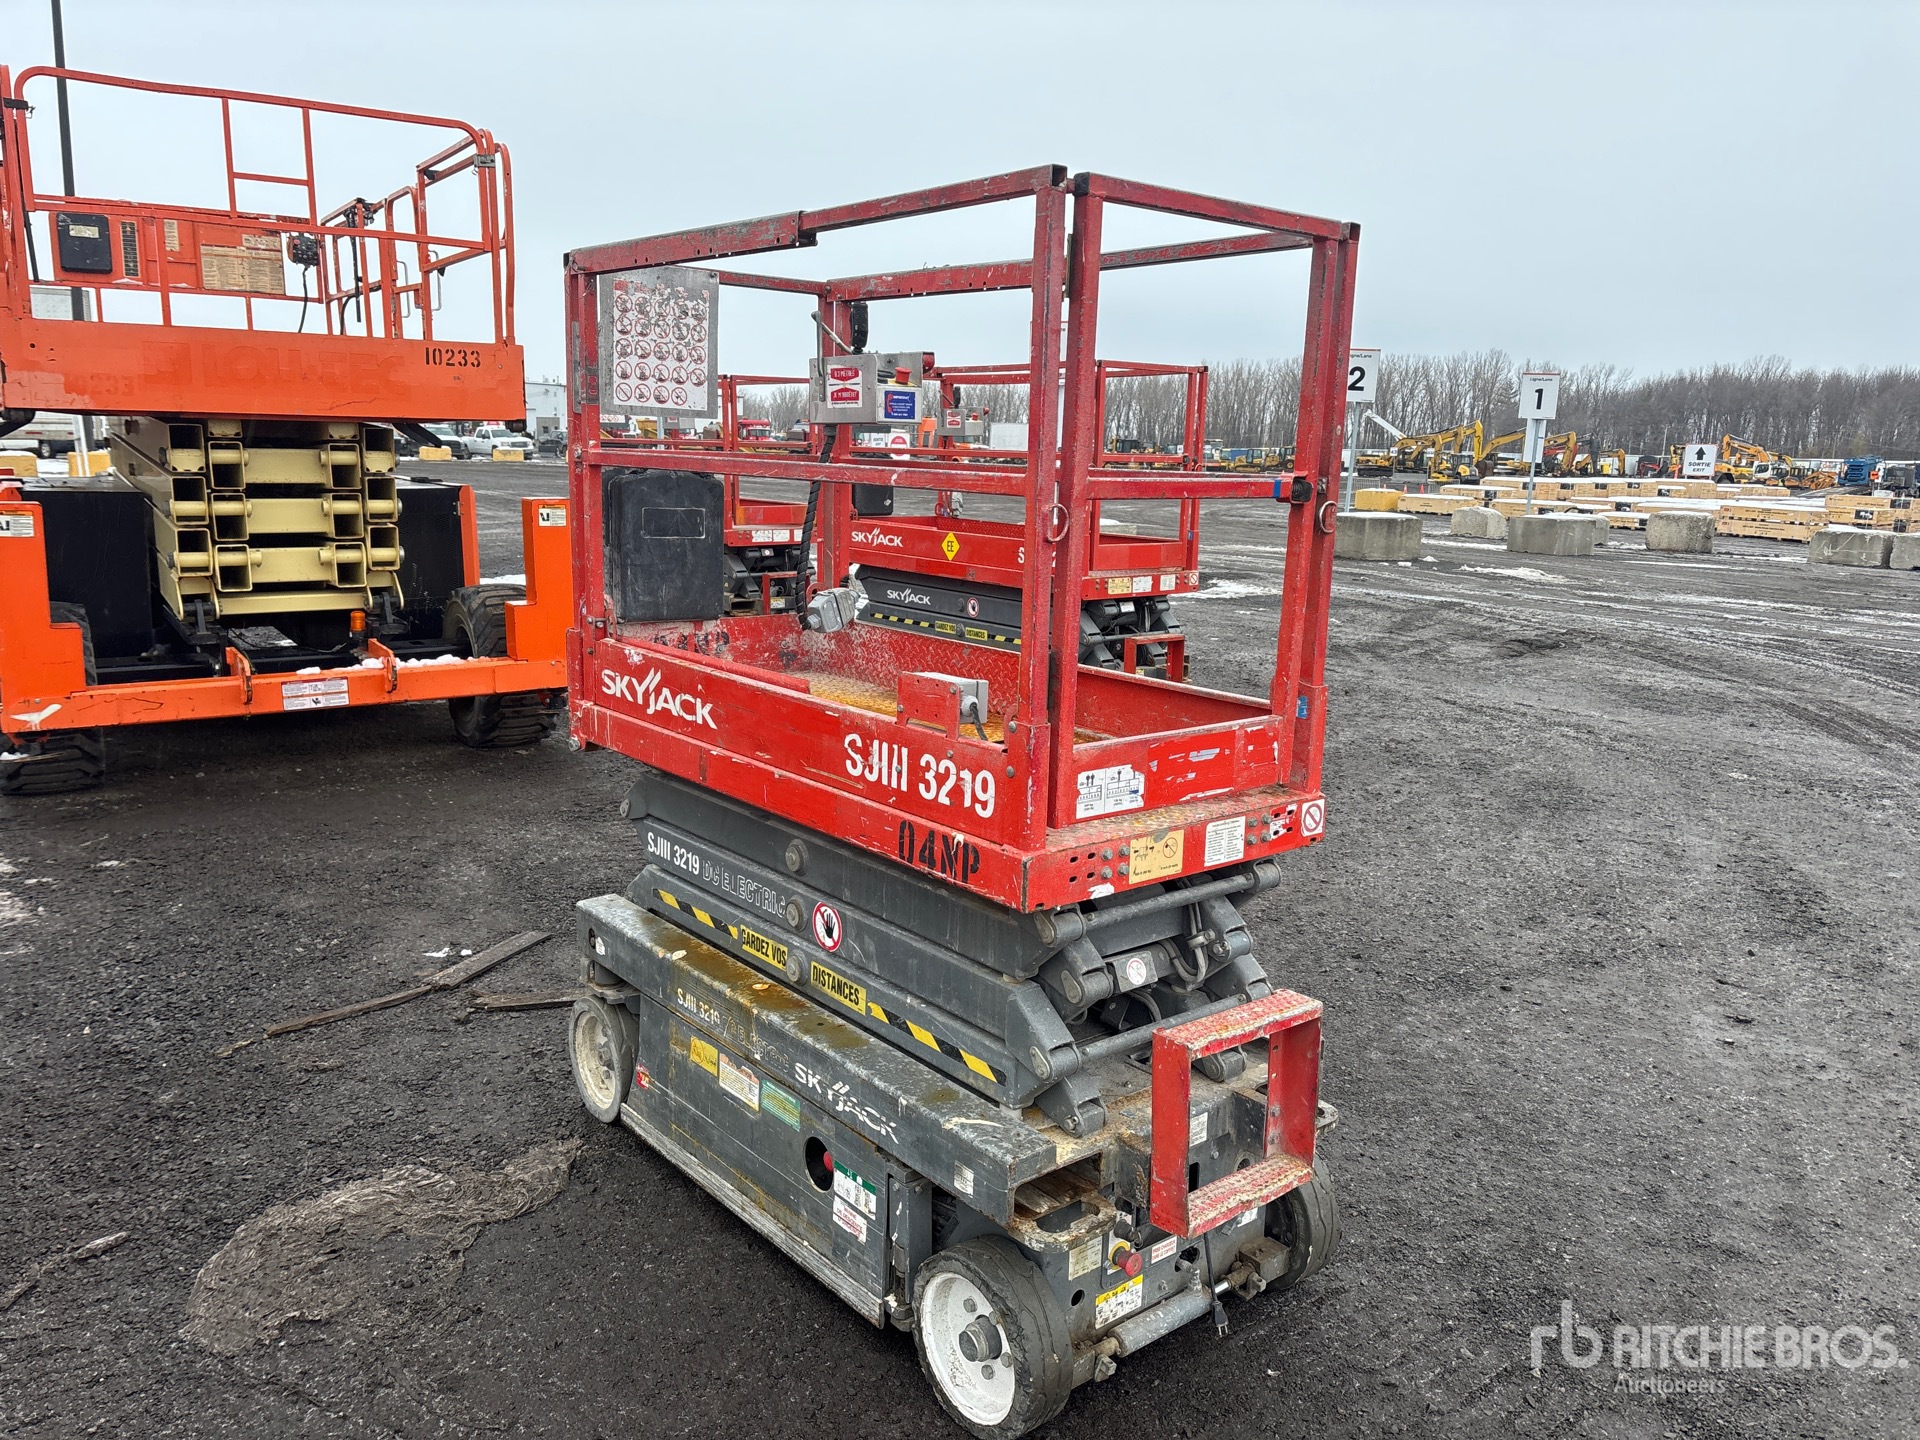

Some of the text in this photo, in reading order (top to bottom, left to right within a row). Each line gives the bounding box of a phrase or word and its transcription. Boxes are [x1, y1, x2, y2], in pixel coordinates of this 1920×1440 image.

[425, 346, 483, 372] 10233
[1347, 366, 1366, 391] 2
[1535, 388, 1544, 410] 1
[851, 527, 903, 547] SKYJACK
[946, 541, 955, 553] EE
[887, 587, 932, 606] SKYJACK
[966, 628, 986, 639] DISTANCES
[602, 667, 718, 730] SKYJACK
[844, 733, 996, 819] SJIII 3219
[647, 832, 671, 862] SJIII
[673, 845, 701, 880] 3219
[741, 929, 861, 1006] GARDEZ VOS DISTANCES
